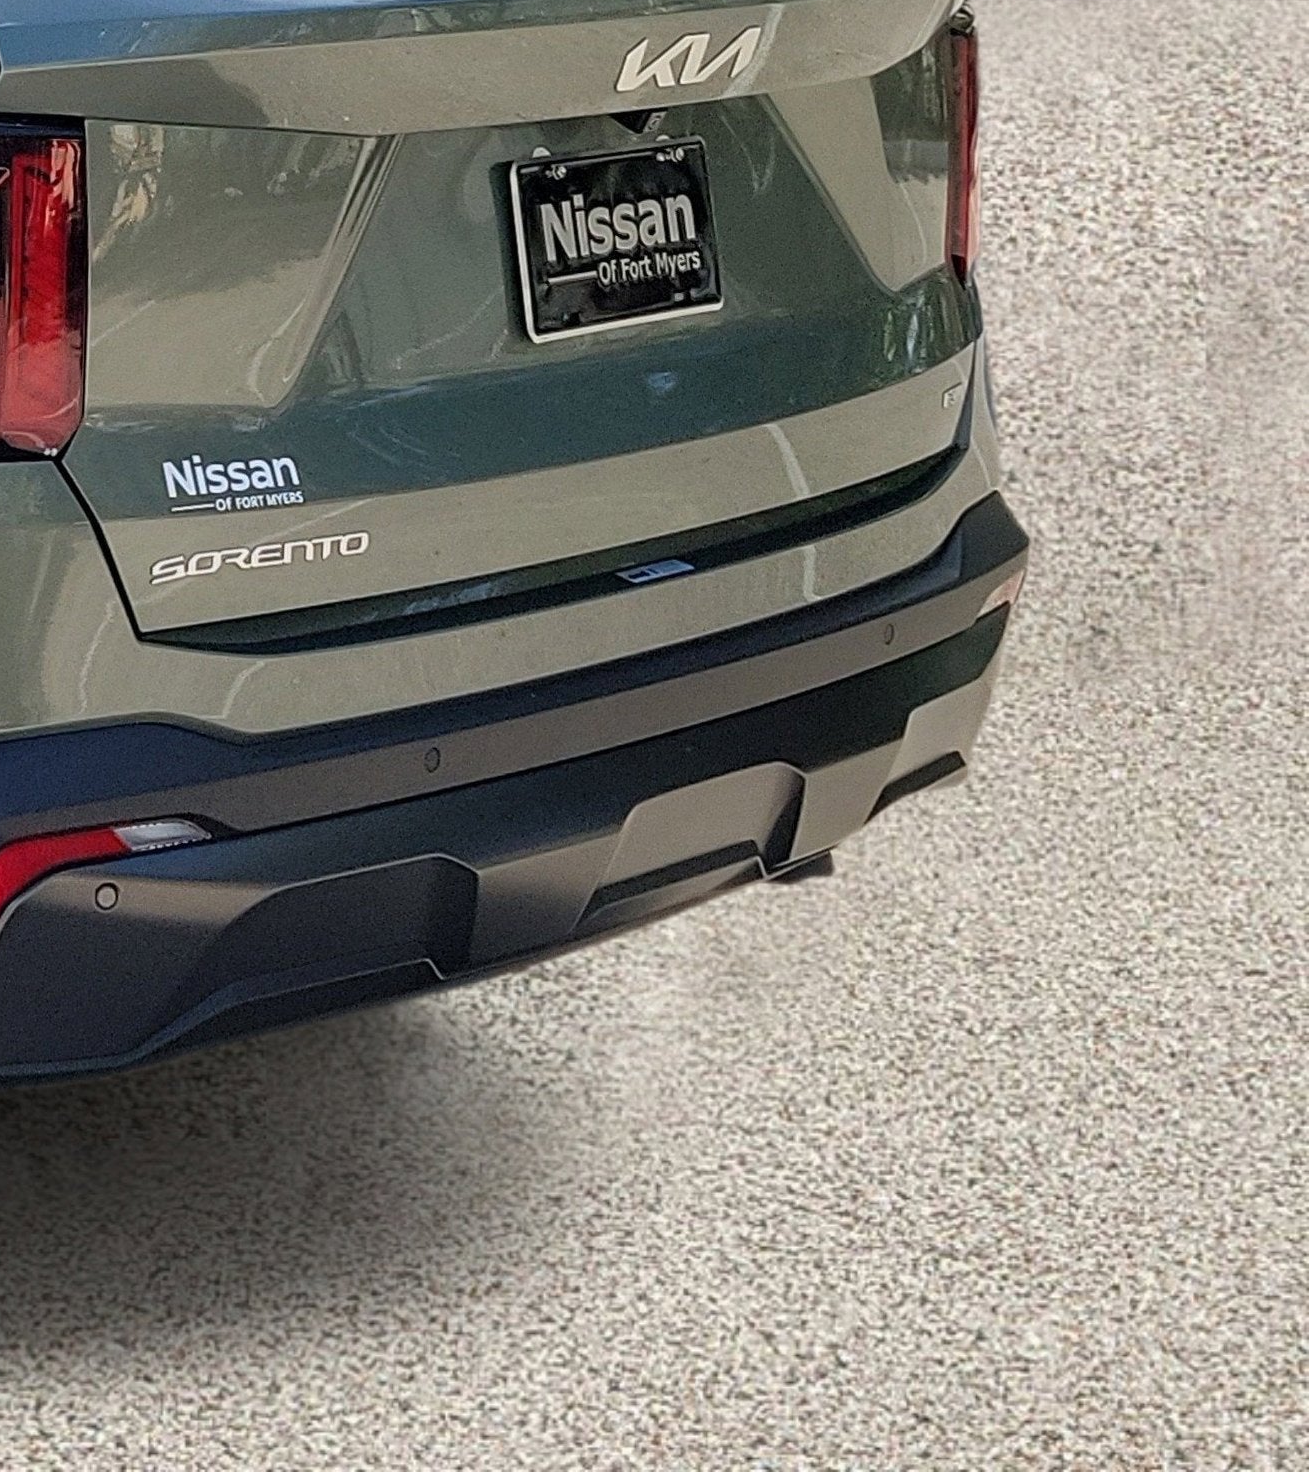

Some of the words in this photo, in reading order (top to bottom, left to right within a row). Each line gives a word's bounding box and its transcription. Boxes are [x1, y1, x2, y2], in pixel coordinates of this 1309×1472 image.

[539, 193, 696, 263] Nissan
[597, 258, 619, 286] Of
[620, 255, 651, 280] Fort
[655, 249, 701, 277] Myers
[162, 454, 300, 499] Nissan
[215, 496, 233, 512] OF
[235, 494, 264, 510] FORT
[266, 491, 304, 507] MYERS
[150, 531, 370, 585] SORENTO
